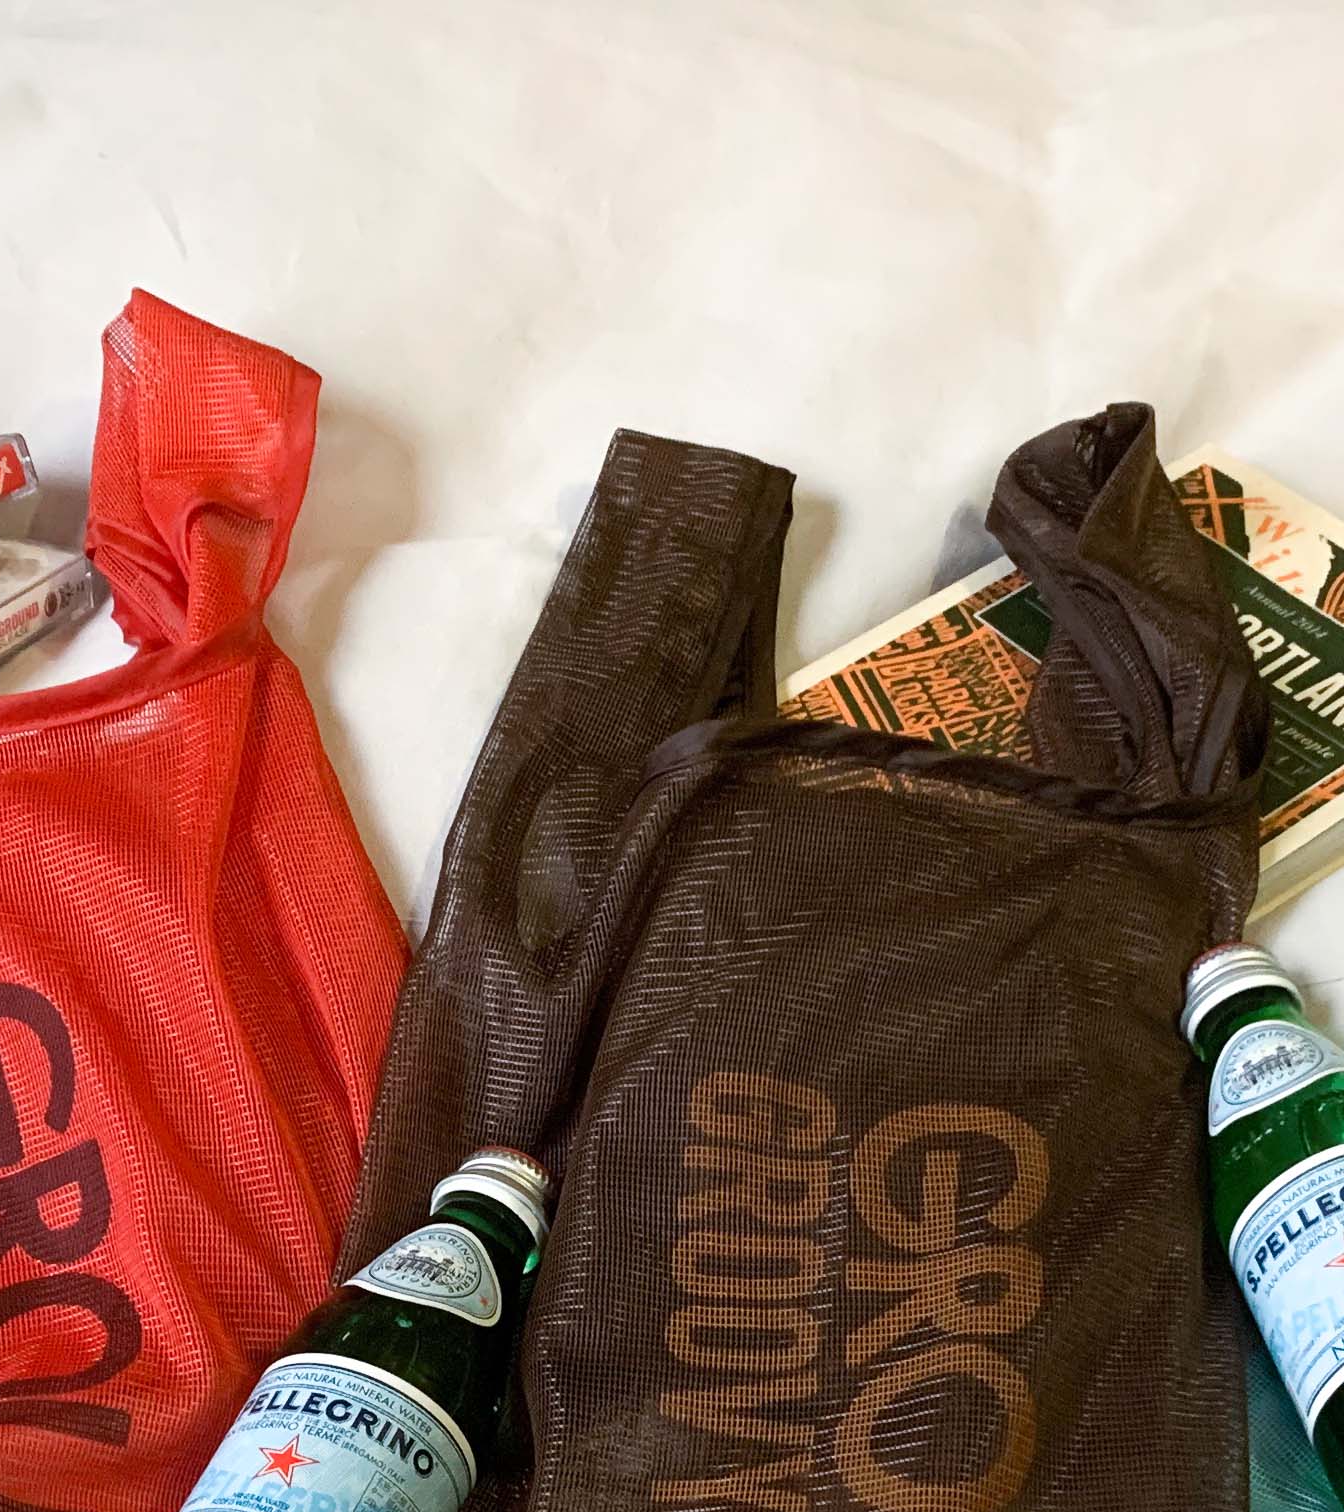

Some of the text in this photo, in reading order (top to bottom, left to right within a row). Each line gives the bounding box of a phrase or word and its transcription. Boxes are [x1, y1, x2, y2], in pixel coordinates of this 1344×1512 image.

[1282, 1173, 1332, 1207] NATURAL
[1279, 1225, 1338, 1273] PELLEGRINO
[294, 1371, 342, 1388] NATURAL
[344, 1381, 395, 1410] MINERAL
[398, 1404, 433, 1437] WATER
[302, 1423, 342, 1445] TERME
